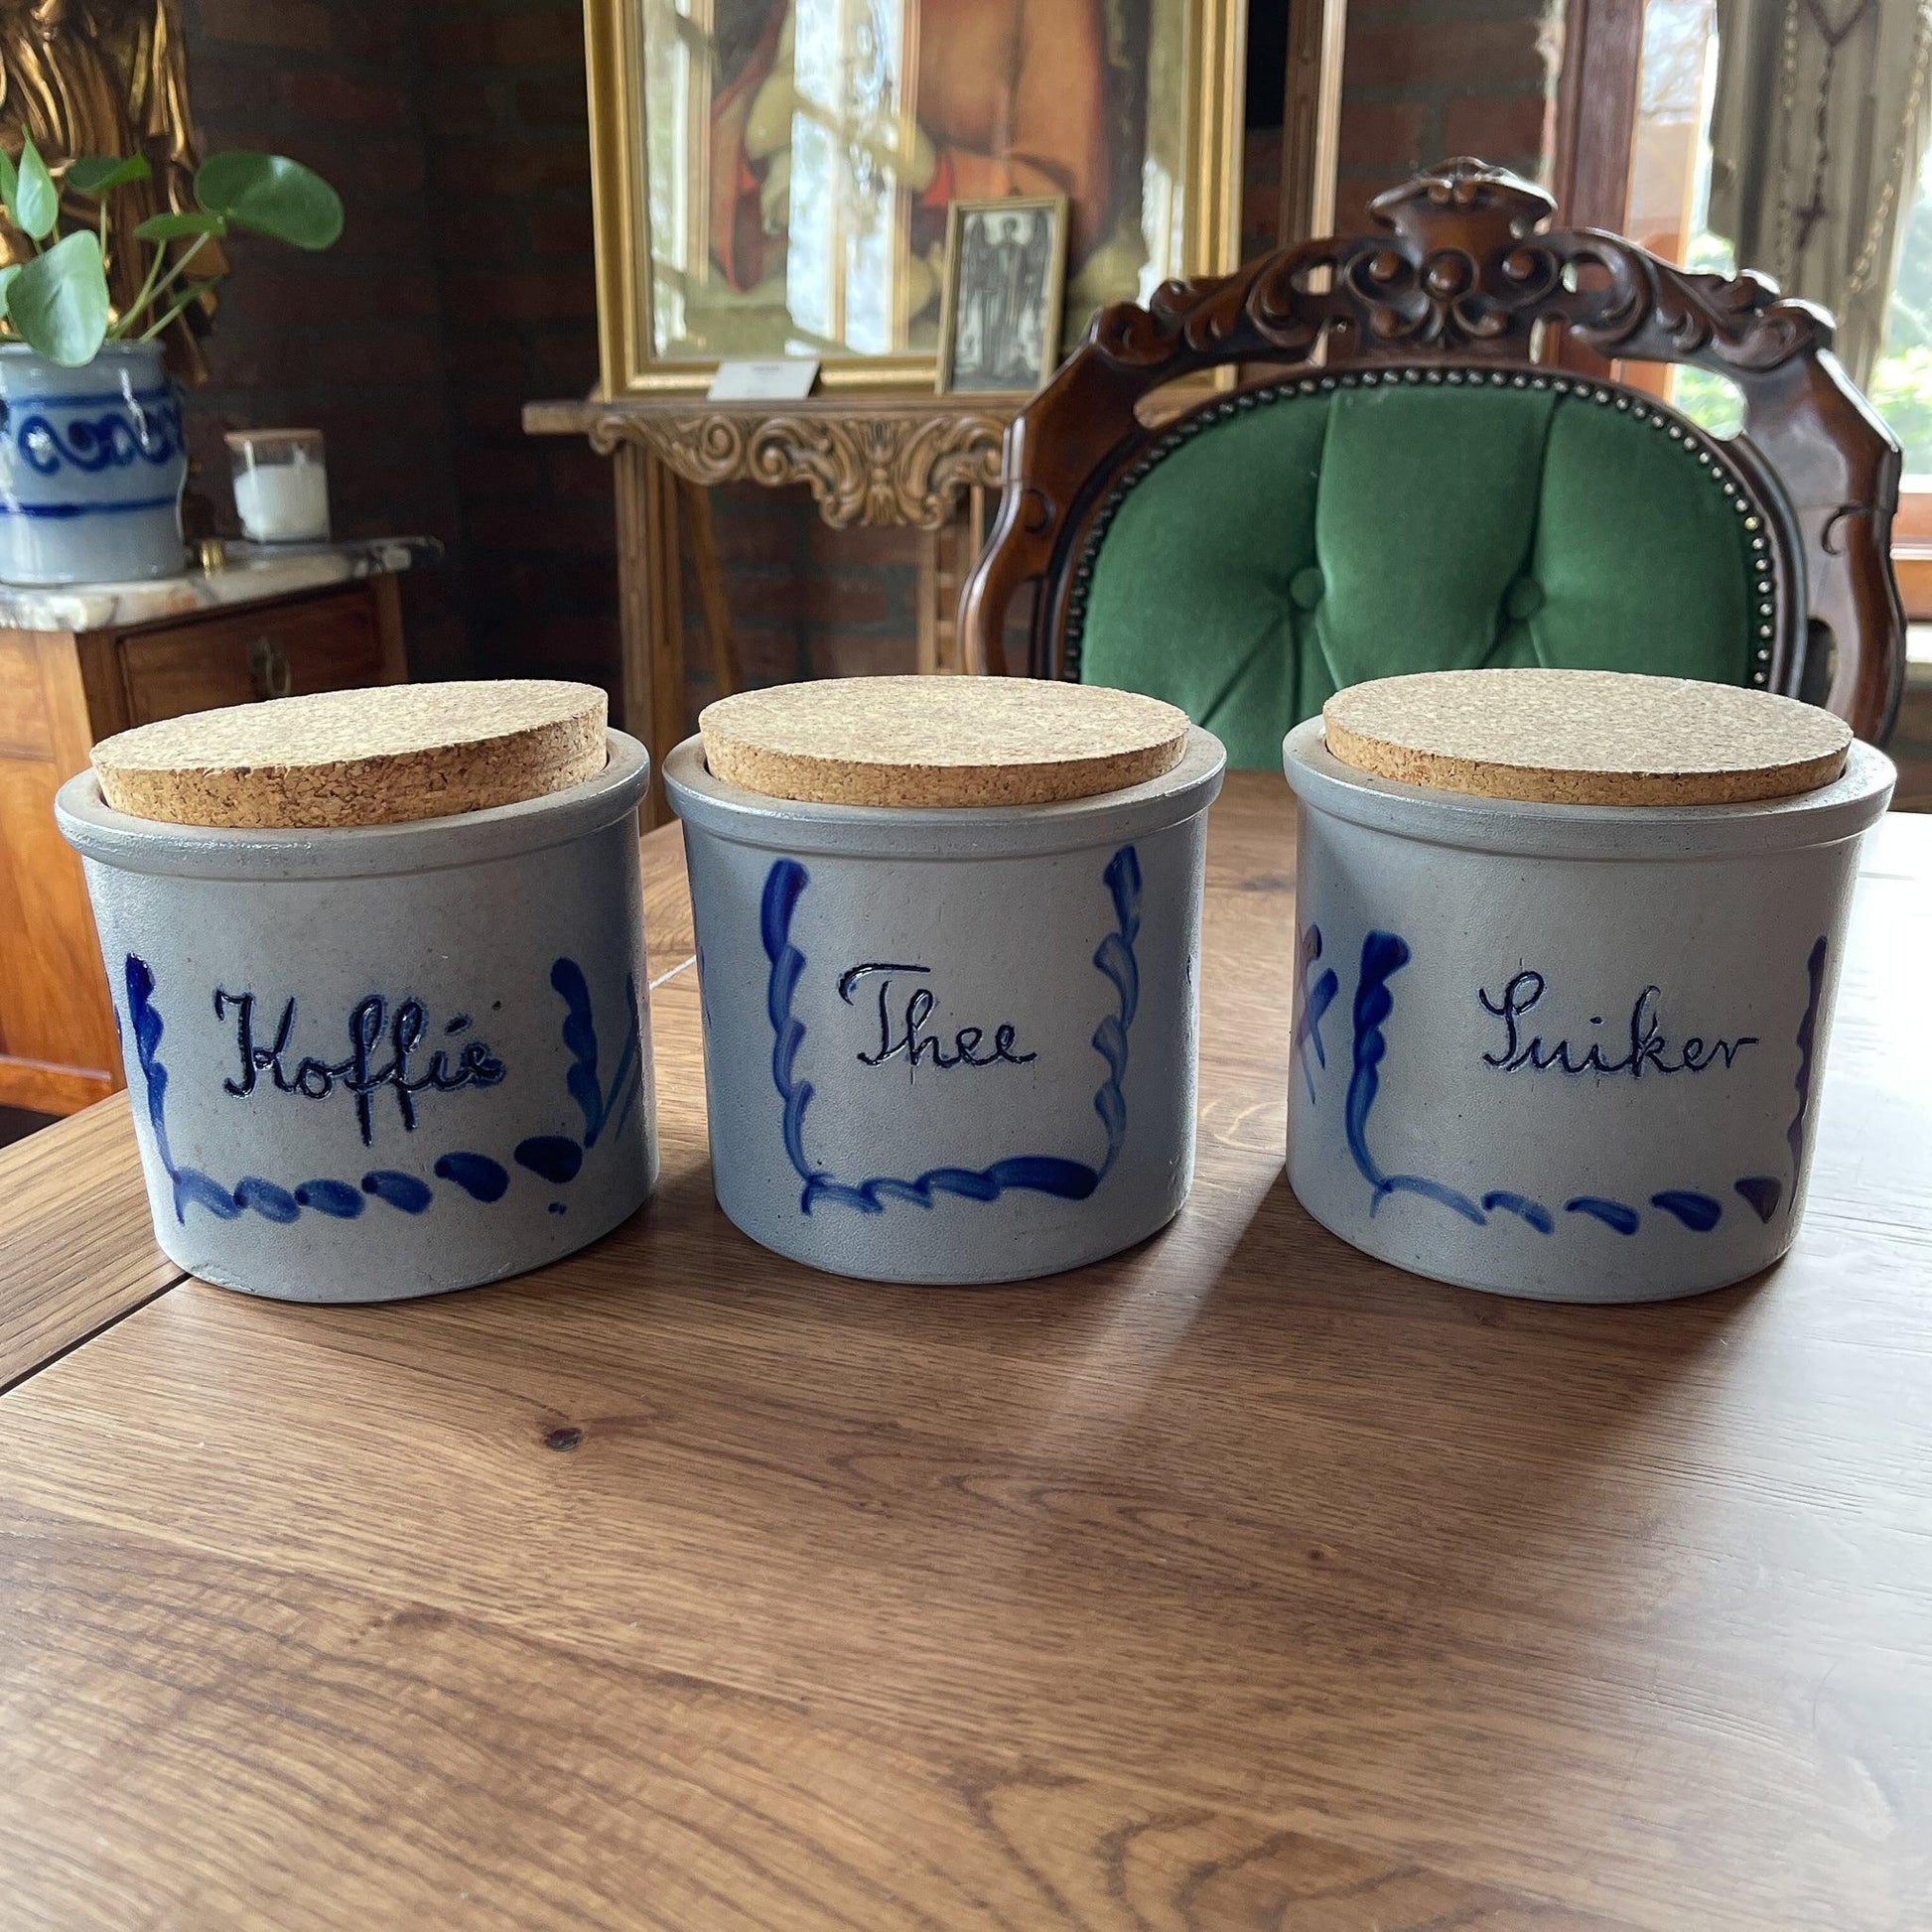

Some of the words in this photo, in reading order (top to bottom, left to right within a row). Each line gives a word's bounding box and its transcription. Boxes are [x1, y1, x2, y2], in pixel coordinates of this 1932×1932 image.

[214, 989, 505, 1146] Koffie
[838, 963, 1037, 1068] Thee
[1478, 971, 1759, 1078] Suiker
